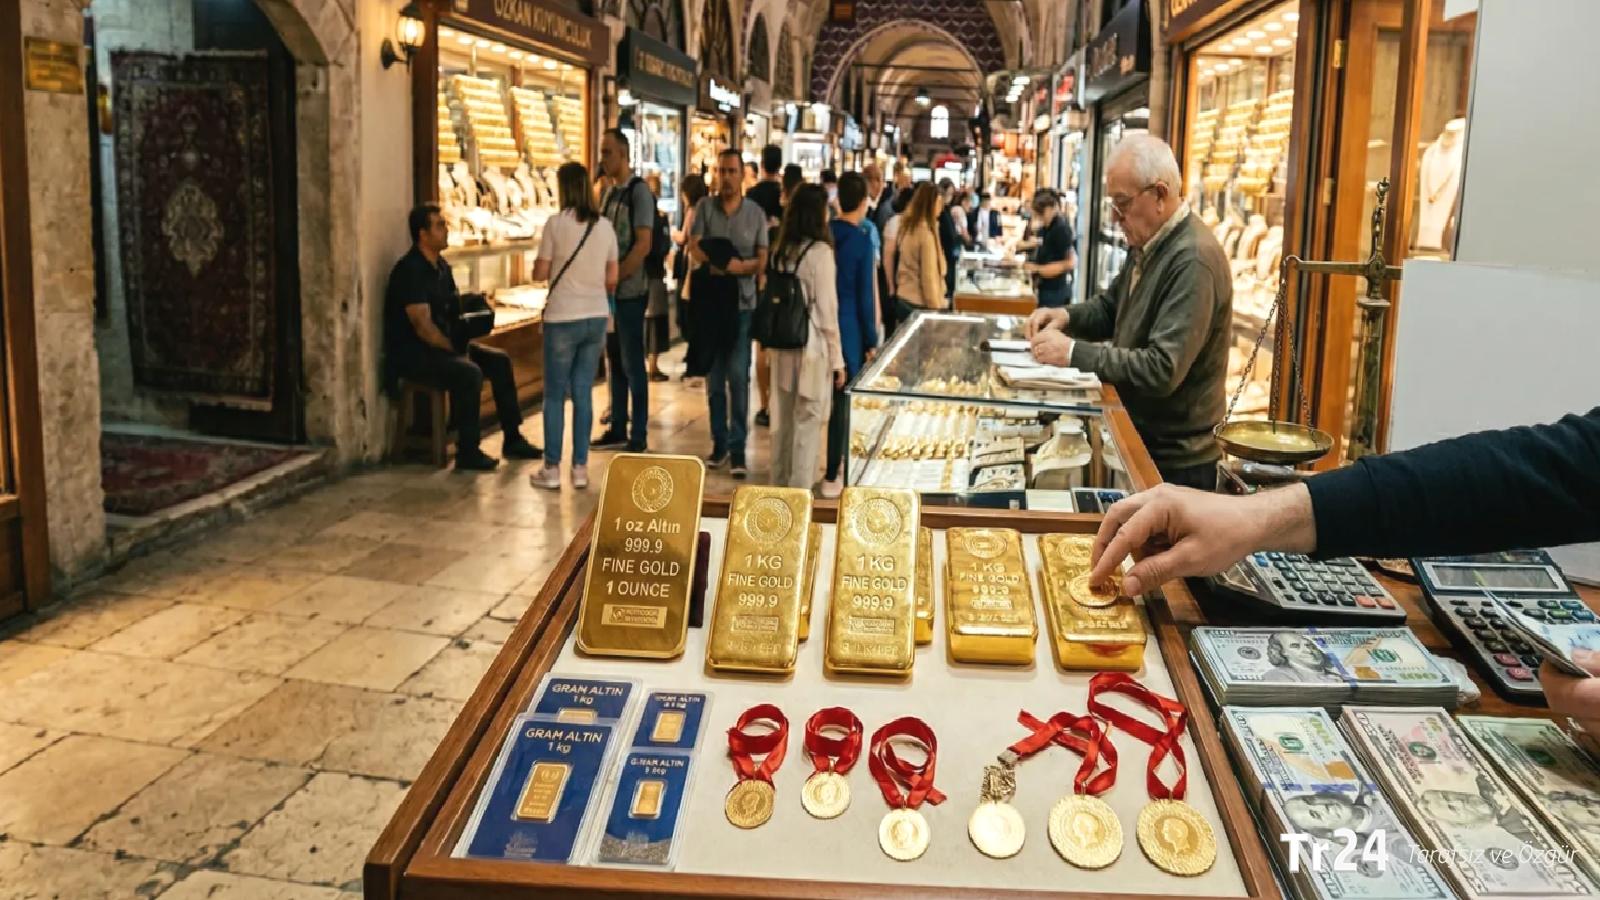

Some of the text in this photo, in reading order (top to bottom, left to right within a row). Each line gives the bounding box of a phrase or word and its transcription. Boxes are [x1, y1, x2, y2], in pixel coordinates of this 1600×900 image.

[614, 517, 621, 531] 1
[625, 520, 643, 532] oz
[625, 537, 663, 554] 999.9
[602, 557, 680, 576] FINE GOLD
[745, 554, 782, 569] 1 KG
[857, 554, 896, 571] 1 KG
[728, 573, 793, 588] FINE GOLD
[841, 575, 907, 591] FINE GOLD
[606, 580, 671, 598] 1 OUNCE
[738, 593, 778, 607] 999.9
[552, 683, 623, 696] GRAM ALTIN
[525, 728, 602, 743] GRAM ALTIN
[548, 742, 571, 754] 1 kg
